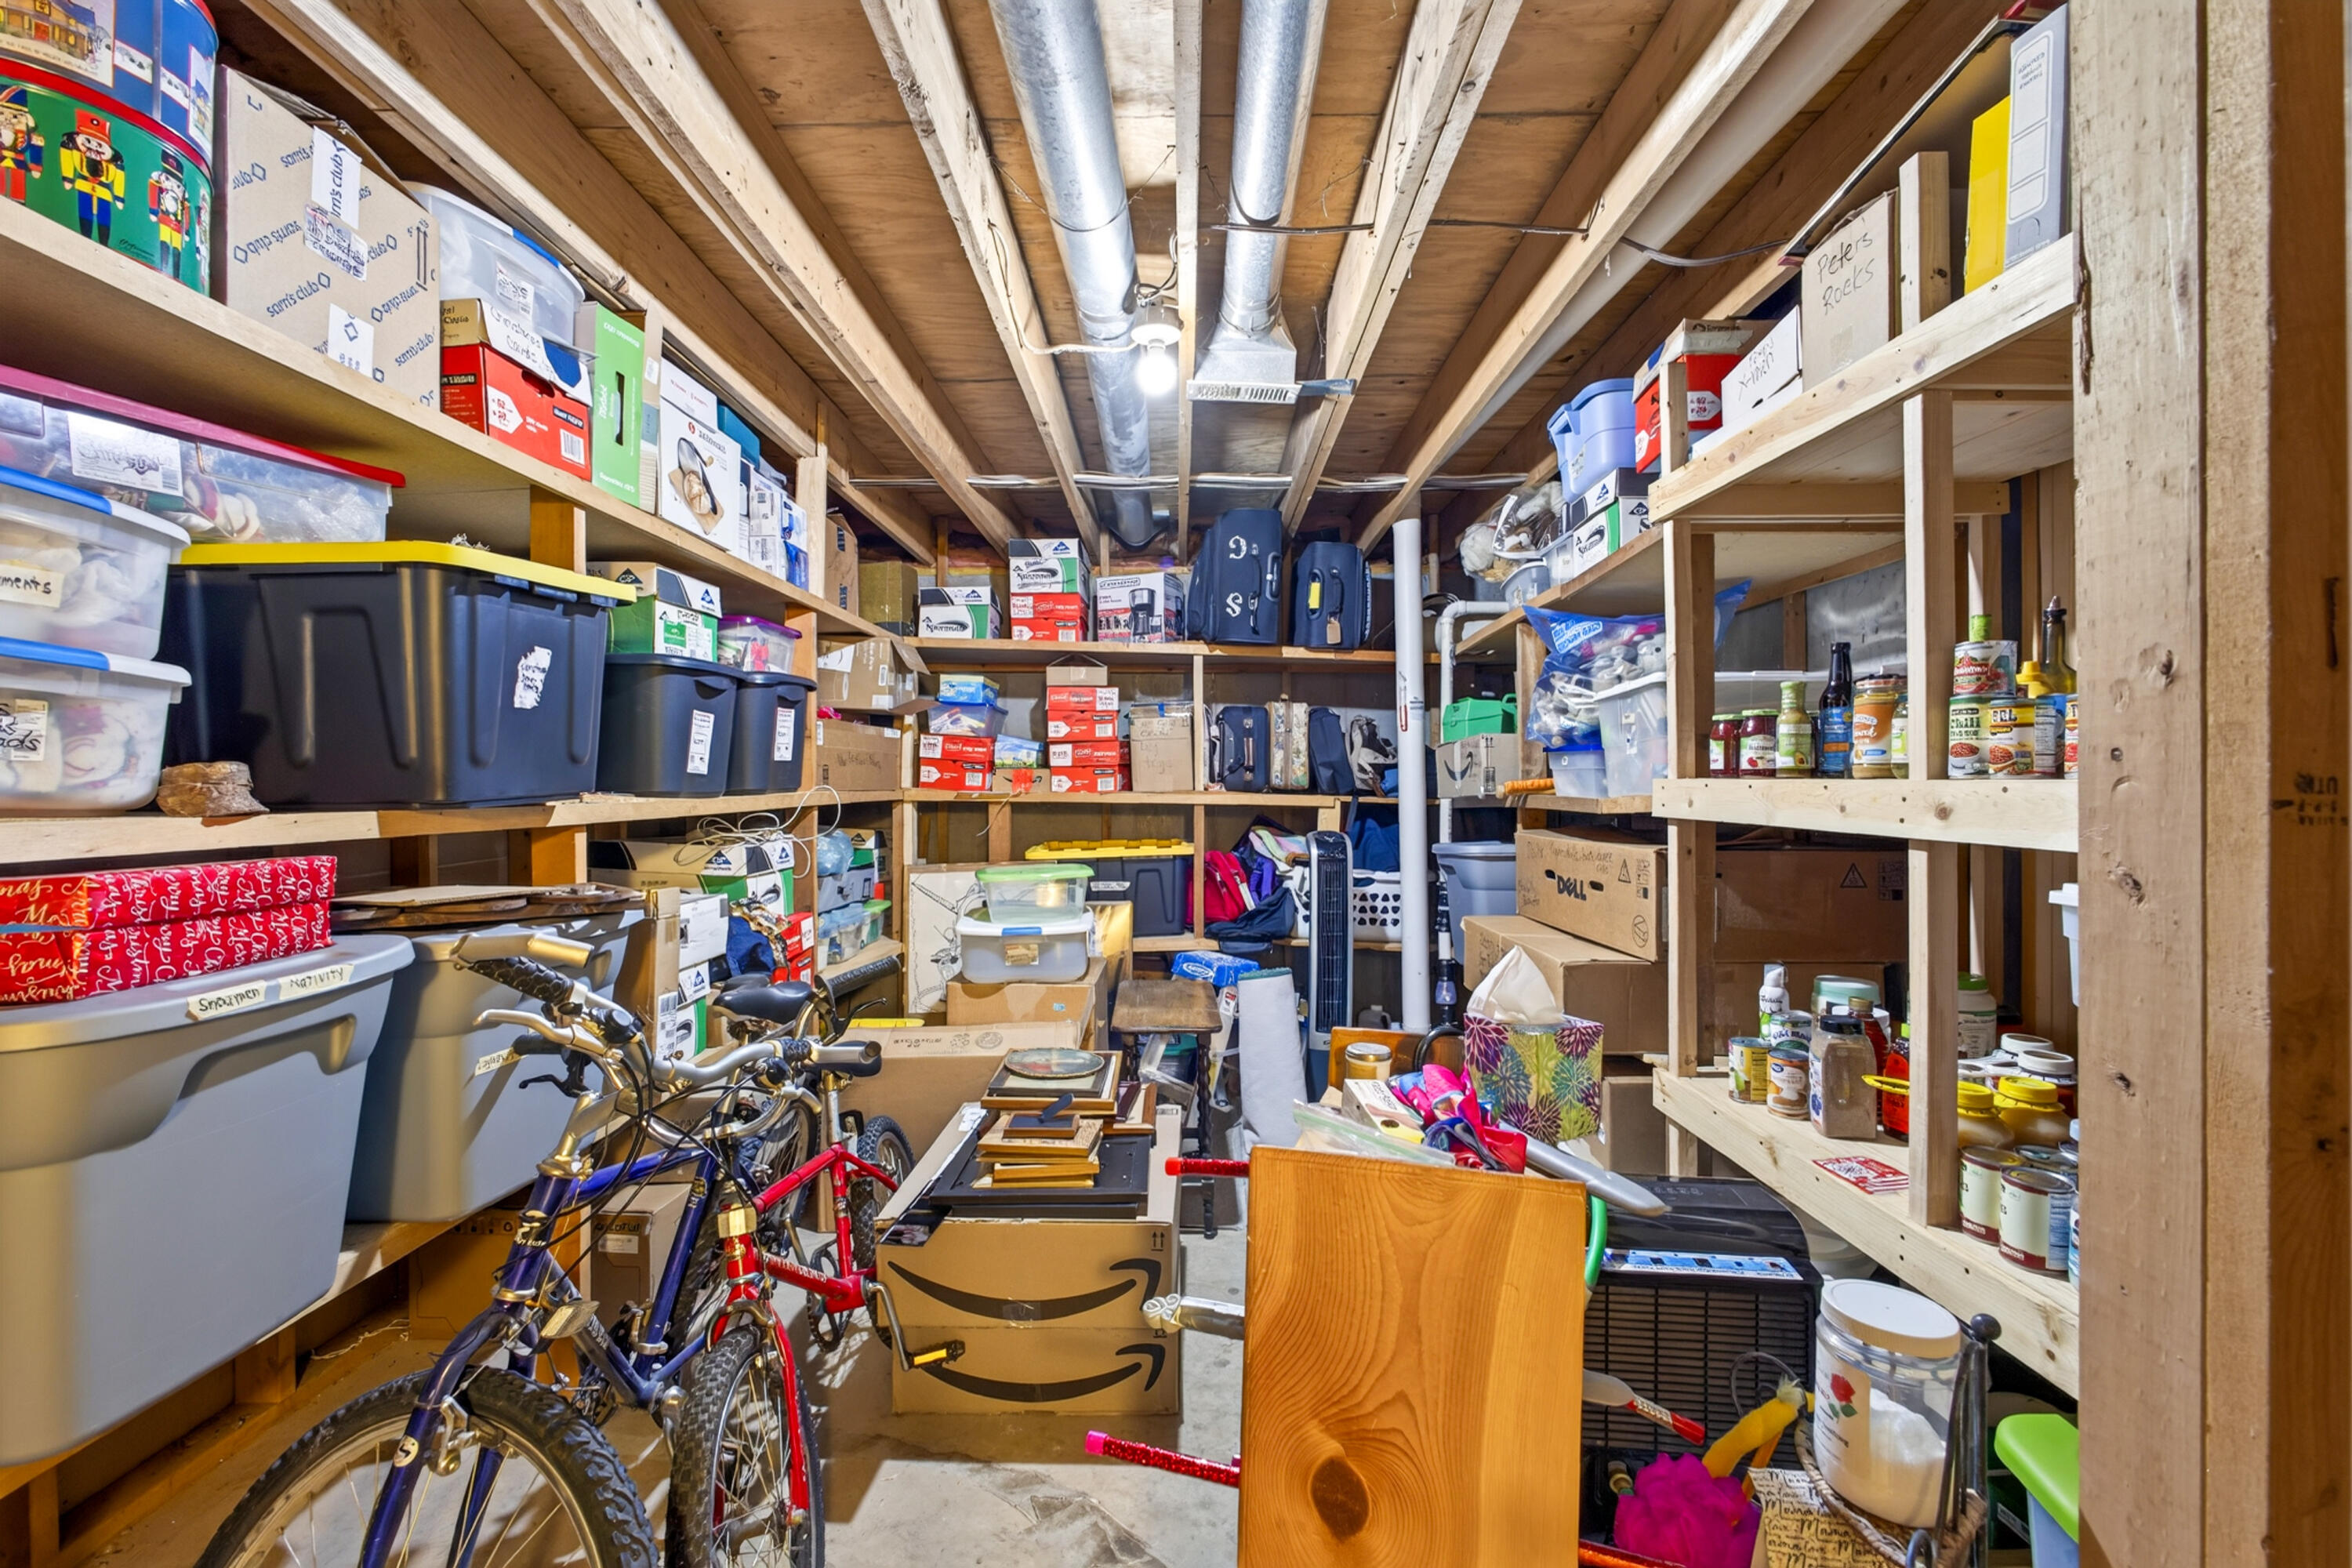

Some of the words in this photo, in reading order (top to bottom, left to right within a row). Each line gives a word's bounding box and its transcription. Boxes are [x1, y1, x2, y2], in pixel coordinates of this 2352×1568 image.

[329, 154, 344, 188] club
[267, 292, 297, 318] sam's
[296, 279, 321, 302] club
[0, 575, 53, 595] ments
[1556, 874, 1587, 902] DELL
